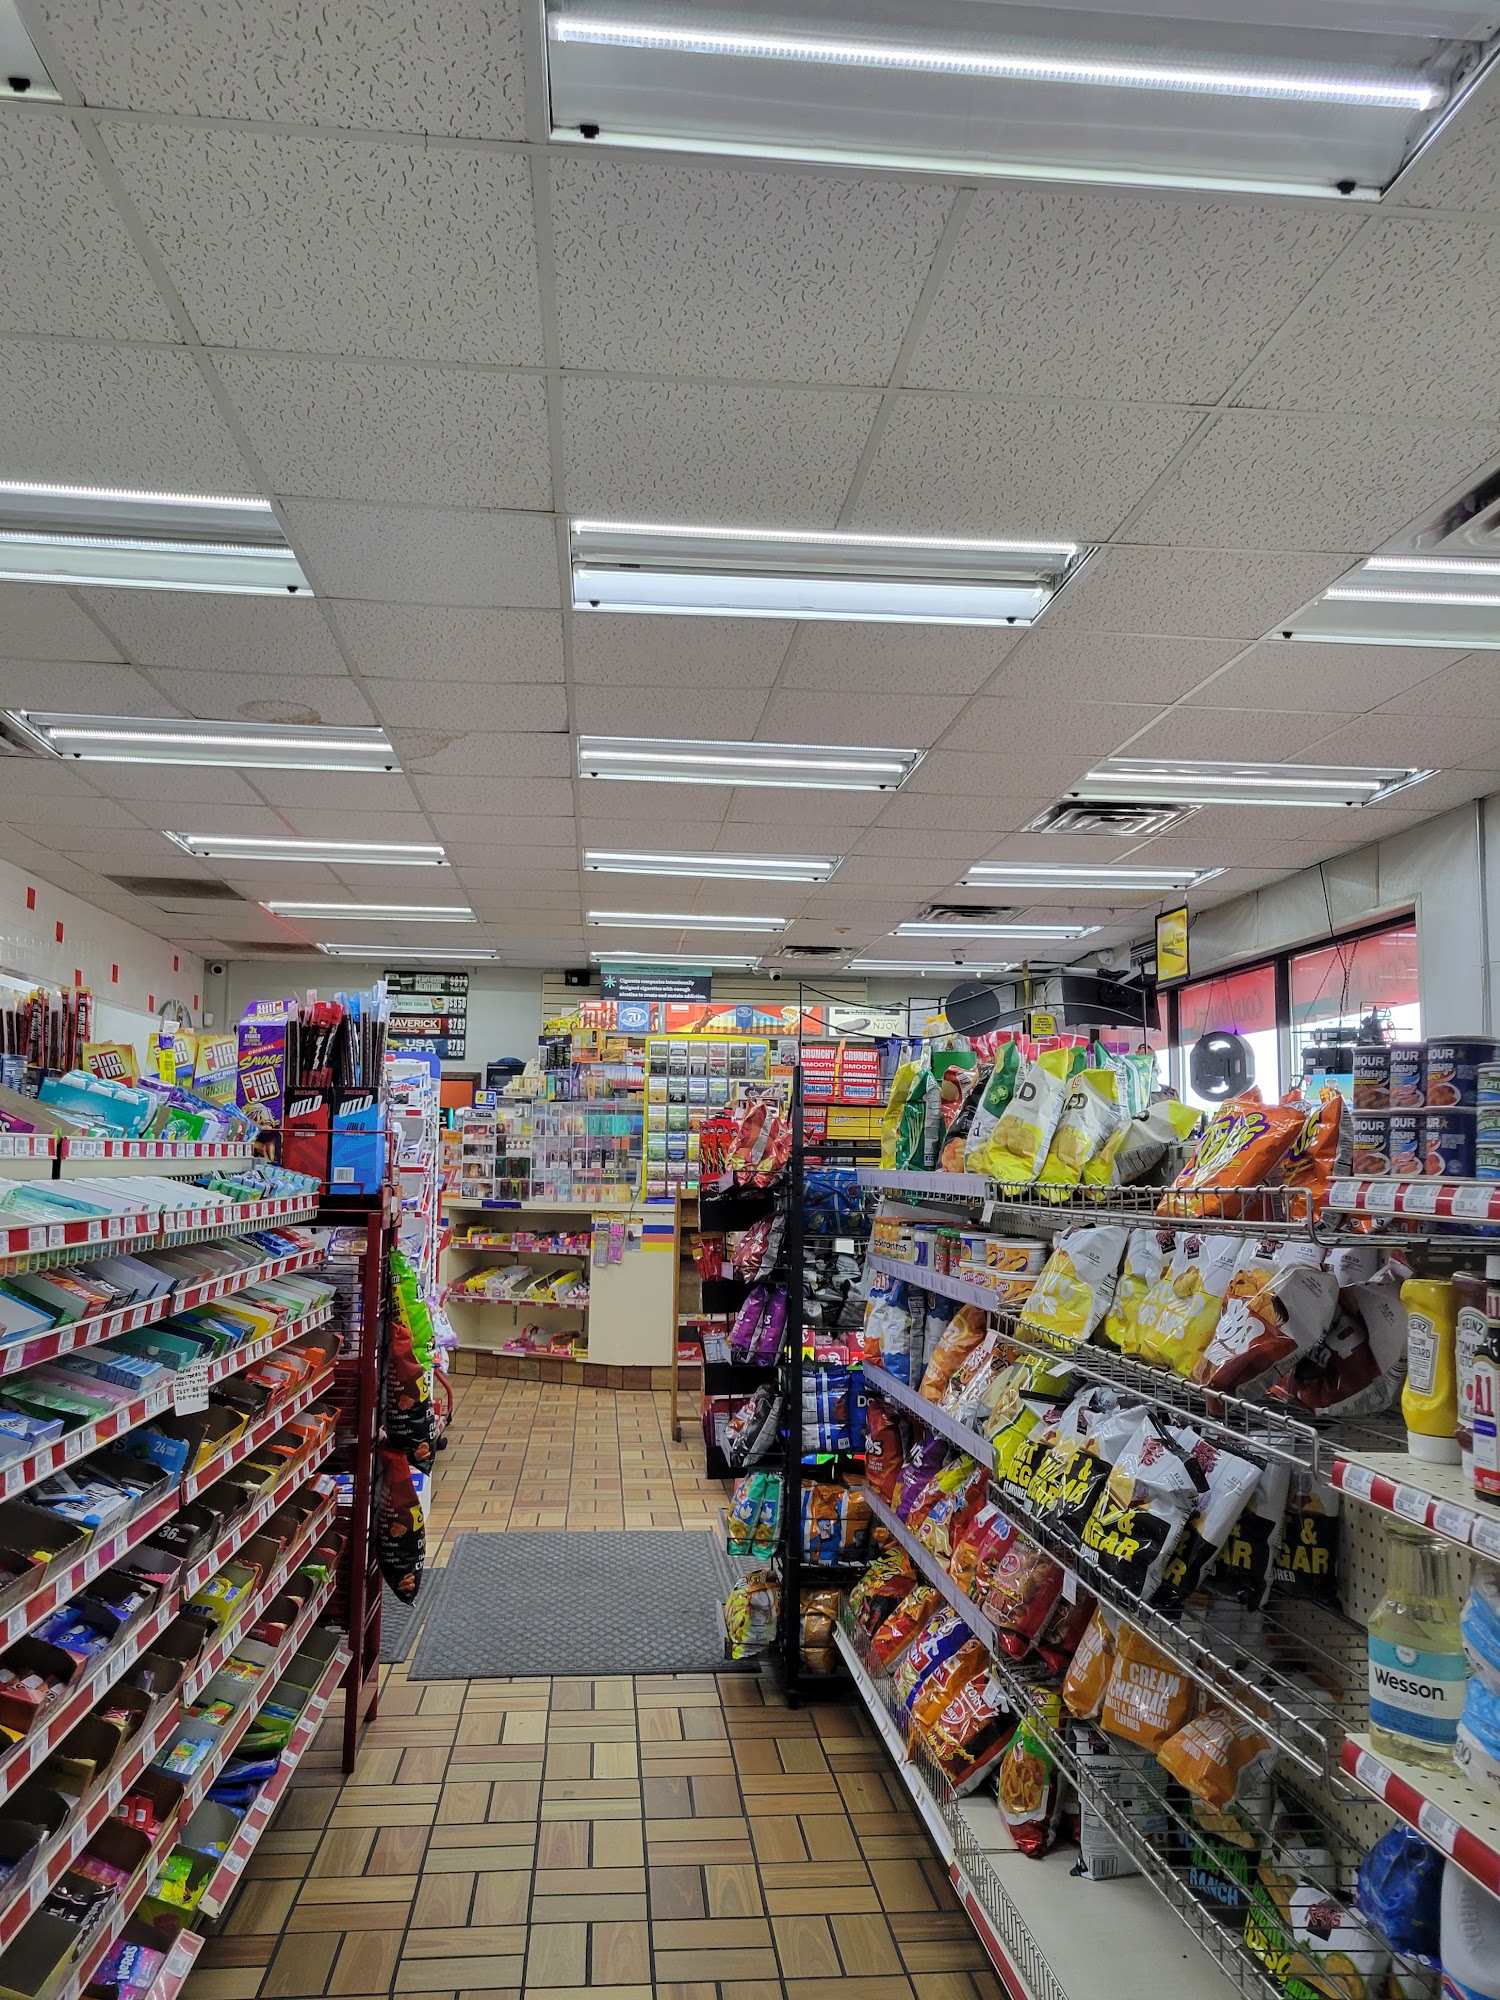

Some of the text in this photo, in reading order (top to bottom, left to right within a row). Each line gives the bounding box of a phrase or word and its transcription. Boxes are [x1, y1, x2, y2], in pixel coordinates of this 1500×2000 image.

[415, 983, 445, 992] MENTHOL
[388, 1018, 437, 1028] MAVERICK
[627, 1012, 641, 1022] 70
[873, 1022, 899, 1030] NJOY
[247, 1044, 275, 1056] ORIGINAL
[405, 1038, 434, 1047] USA
[801, 1048, 836, 1060] CRUNCHY
[843, 1051, 878, 1062] CRUNCHY
[238, 1053, 284, 1071] SAVAGE
[222, 1068, 237, 1077] BBQ
[289, 1094, 323, 1119] WILD
[339, 1094, 374, 1119] WILD
[153, 1440, 166, 1455] 24
[158, 1525, 180, 1541] 36
[1301, 1518, 1318, 1546] &
[1129, 1662, 1180, 1698] CREAM
[1374, 1666, 1444, 1701] Wesson
[1108, 1680, 1170, 1717] CHEDDAR
[1189, 1867, 1240, 1907] RANCH
